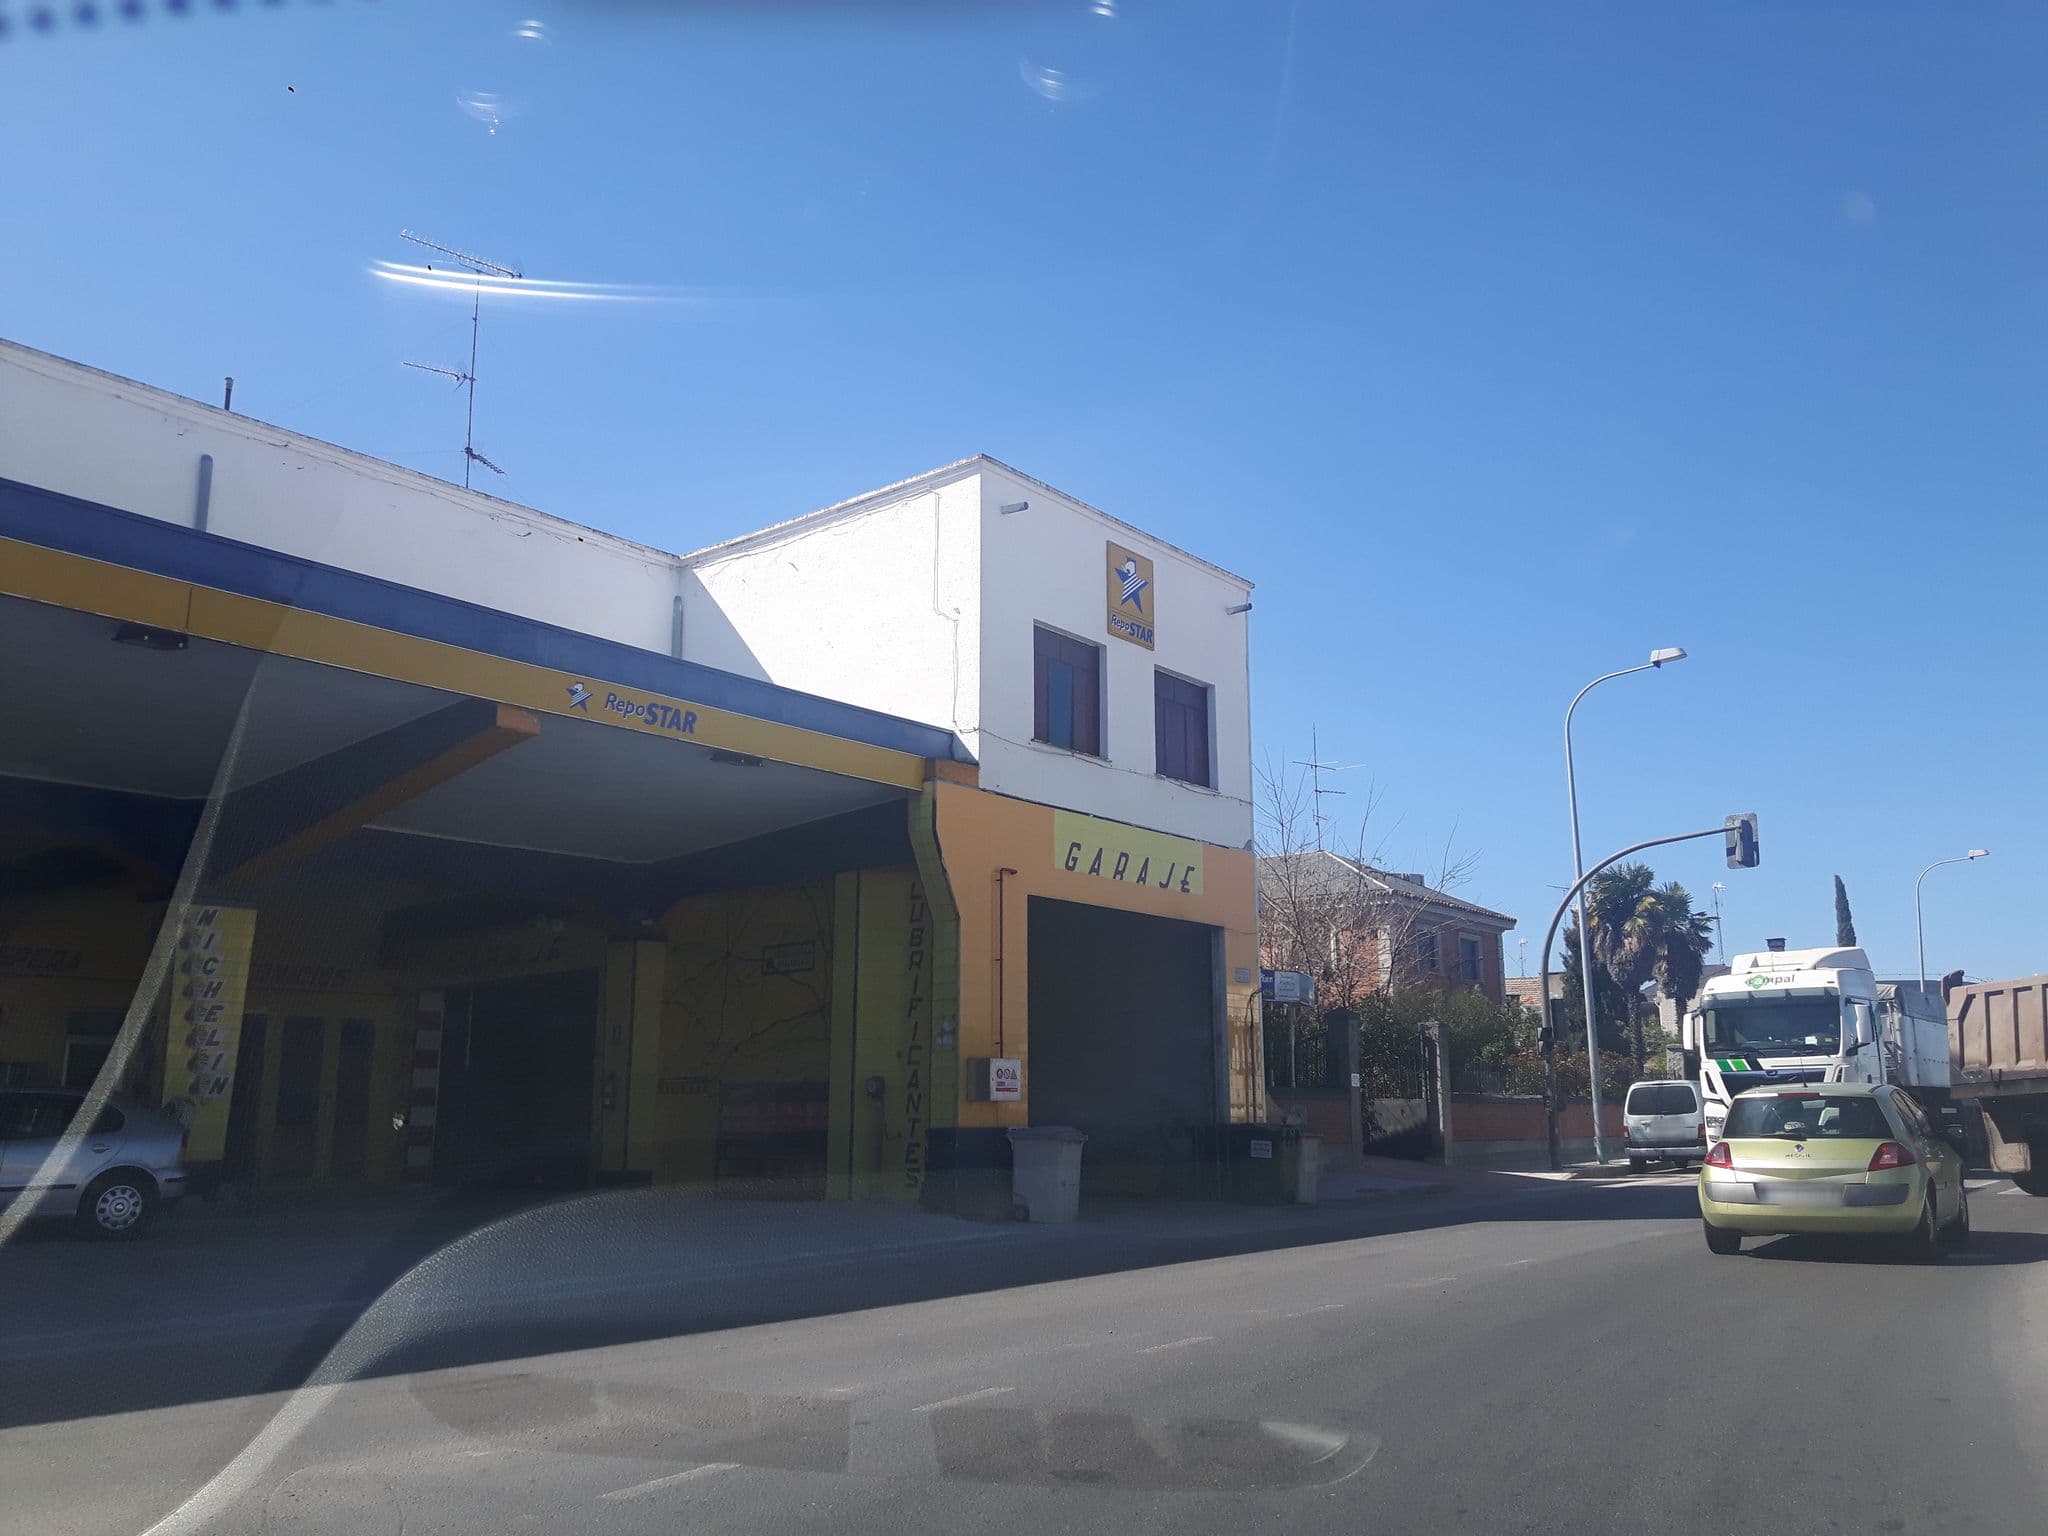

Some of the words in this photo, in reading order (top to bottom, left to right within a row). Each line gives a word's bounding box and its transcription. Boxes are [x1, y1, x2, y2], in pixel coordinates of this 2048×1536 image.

[1111, 614, 1153, 643] RepoSTAR
[604, 692, 698, 734] RepoSTAR
[1064, 841, 1196, 893] GARAJE
[196, 908, 230, 1095] MICHELIN
[904, 882, 924, 1188] LUBRIFICANTES
